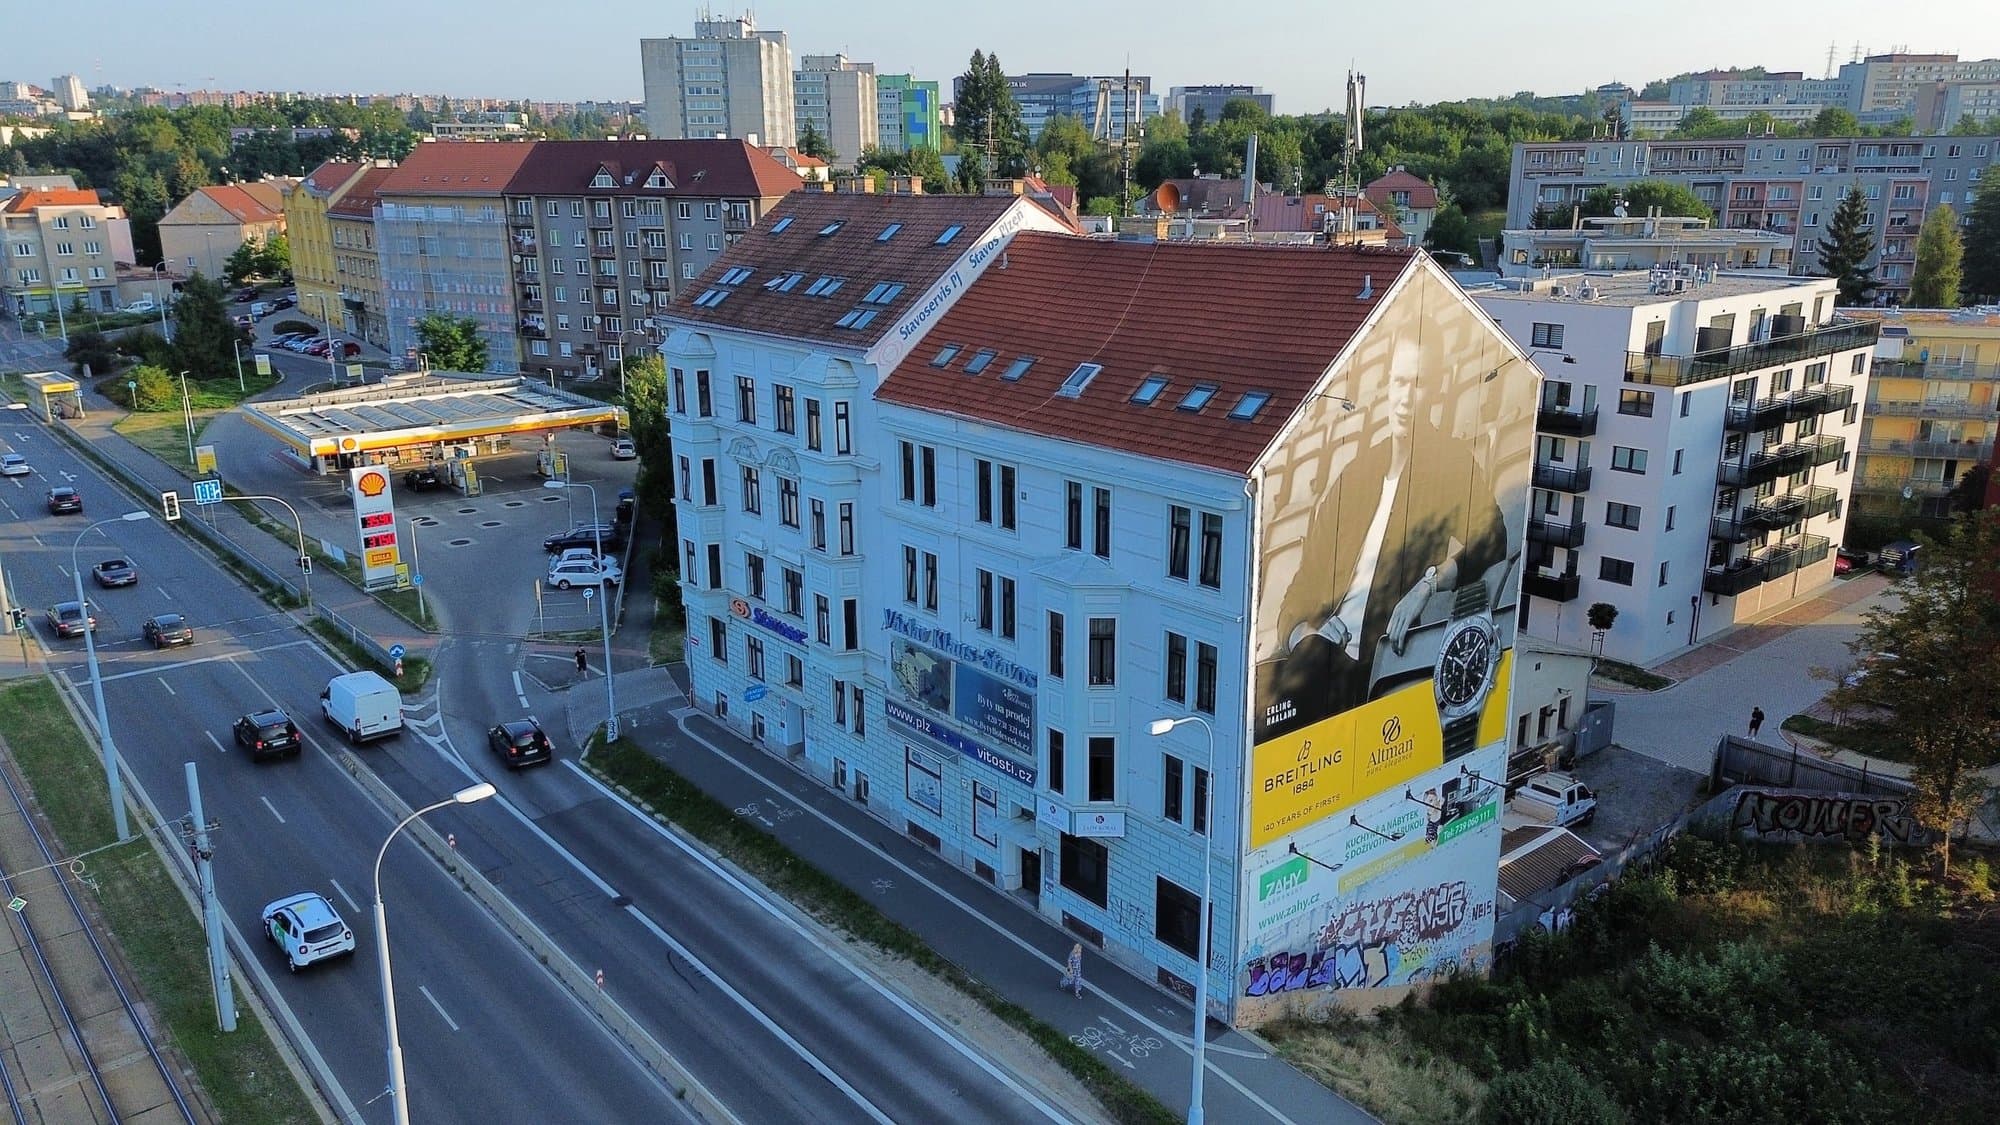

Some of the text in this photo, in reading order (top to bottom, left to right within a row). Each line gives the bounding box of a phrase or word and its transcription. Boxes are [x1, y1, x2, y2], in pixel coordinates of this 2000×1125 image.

[968, 205, 1025, 269] Stavos Plzeň
[899, 271, 963, 340] Stavoservis PJ
[995, 703, 1004, 715] na
[1005, 708, 1030, 728] prodej
[1266, 700, 1292, 716] ERLING
[1266, 708, 1297, 727] HAALAND
[1367, 738, 1413, 769] Altman
[1264, 750, 1342, 793] BREITLING
[1293, 778, 1314, 796] 1884
[1263, 793, 1341, 833] 140 YEARS OF FIRSTS
[1480, 809, 1490, 822] 111
[1266, 869, 1302, 900] ZAHY
[1258, 893, 1320, 930] www.zahy.cz
